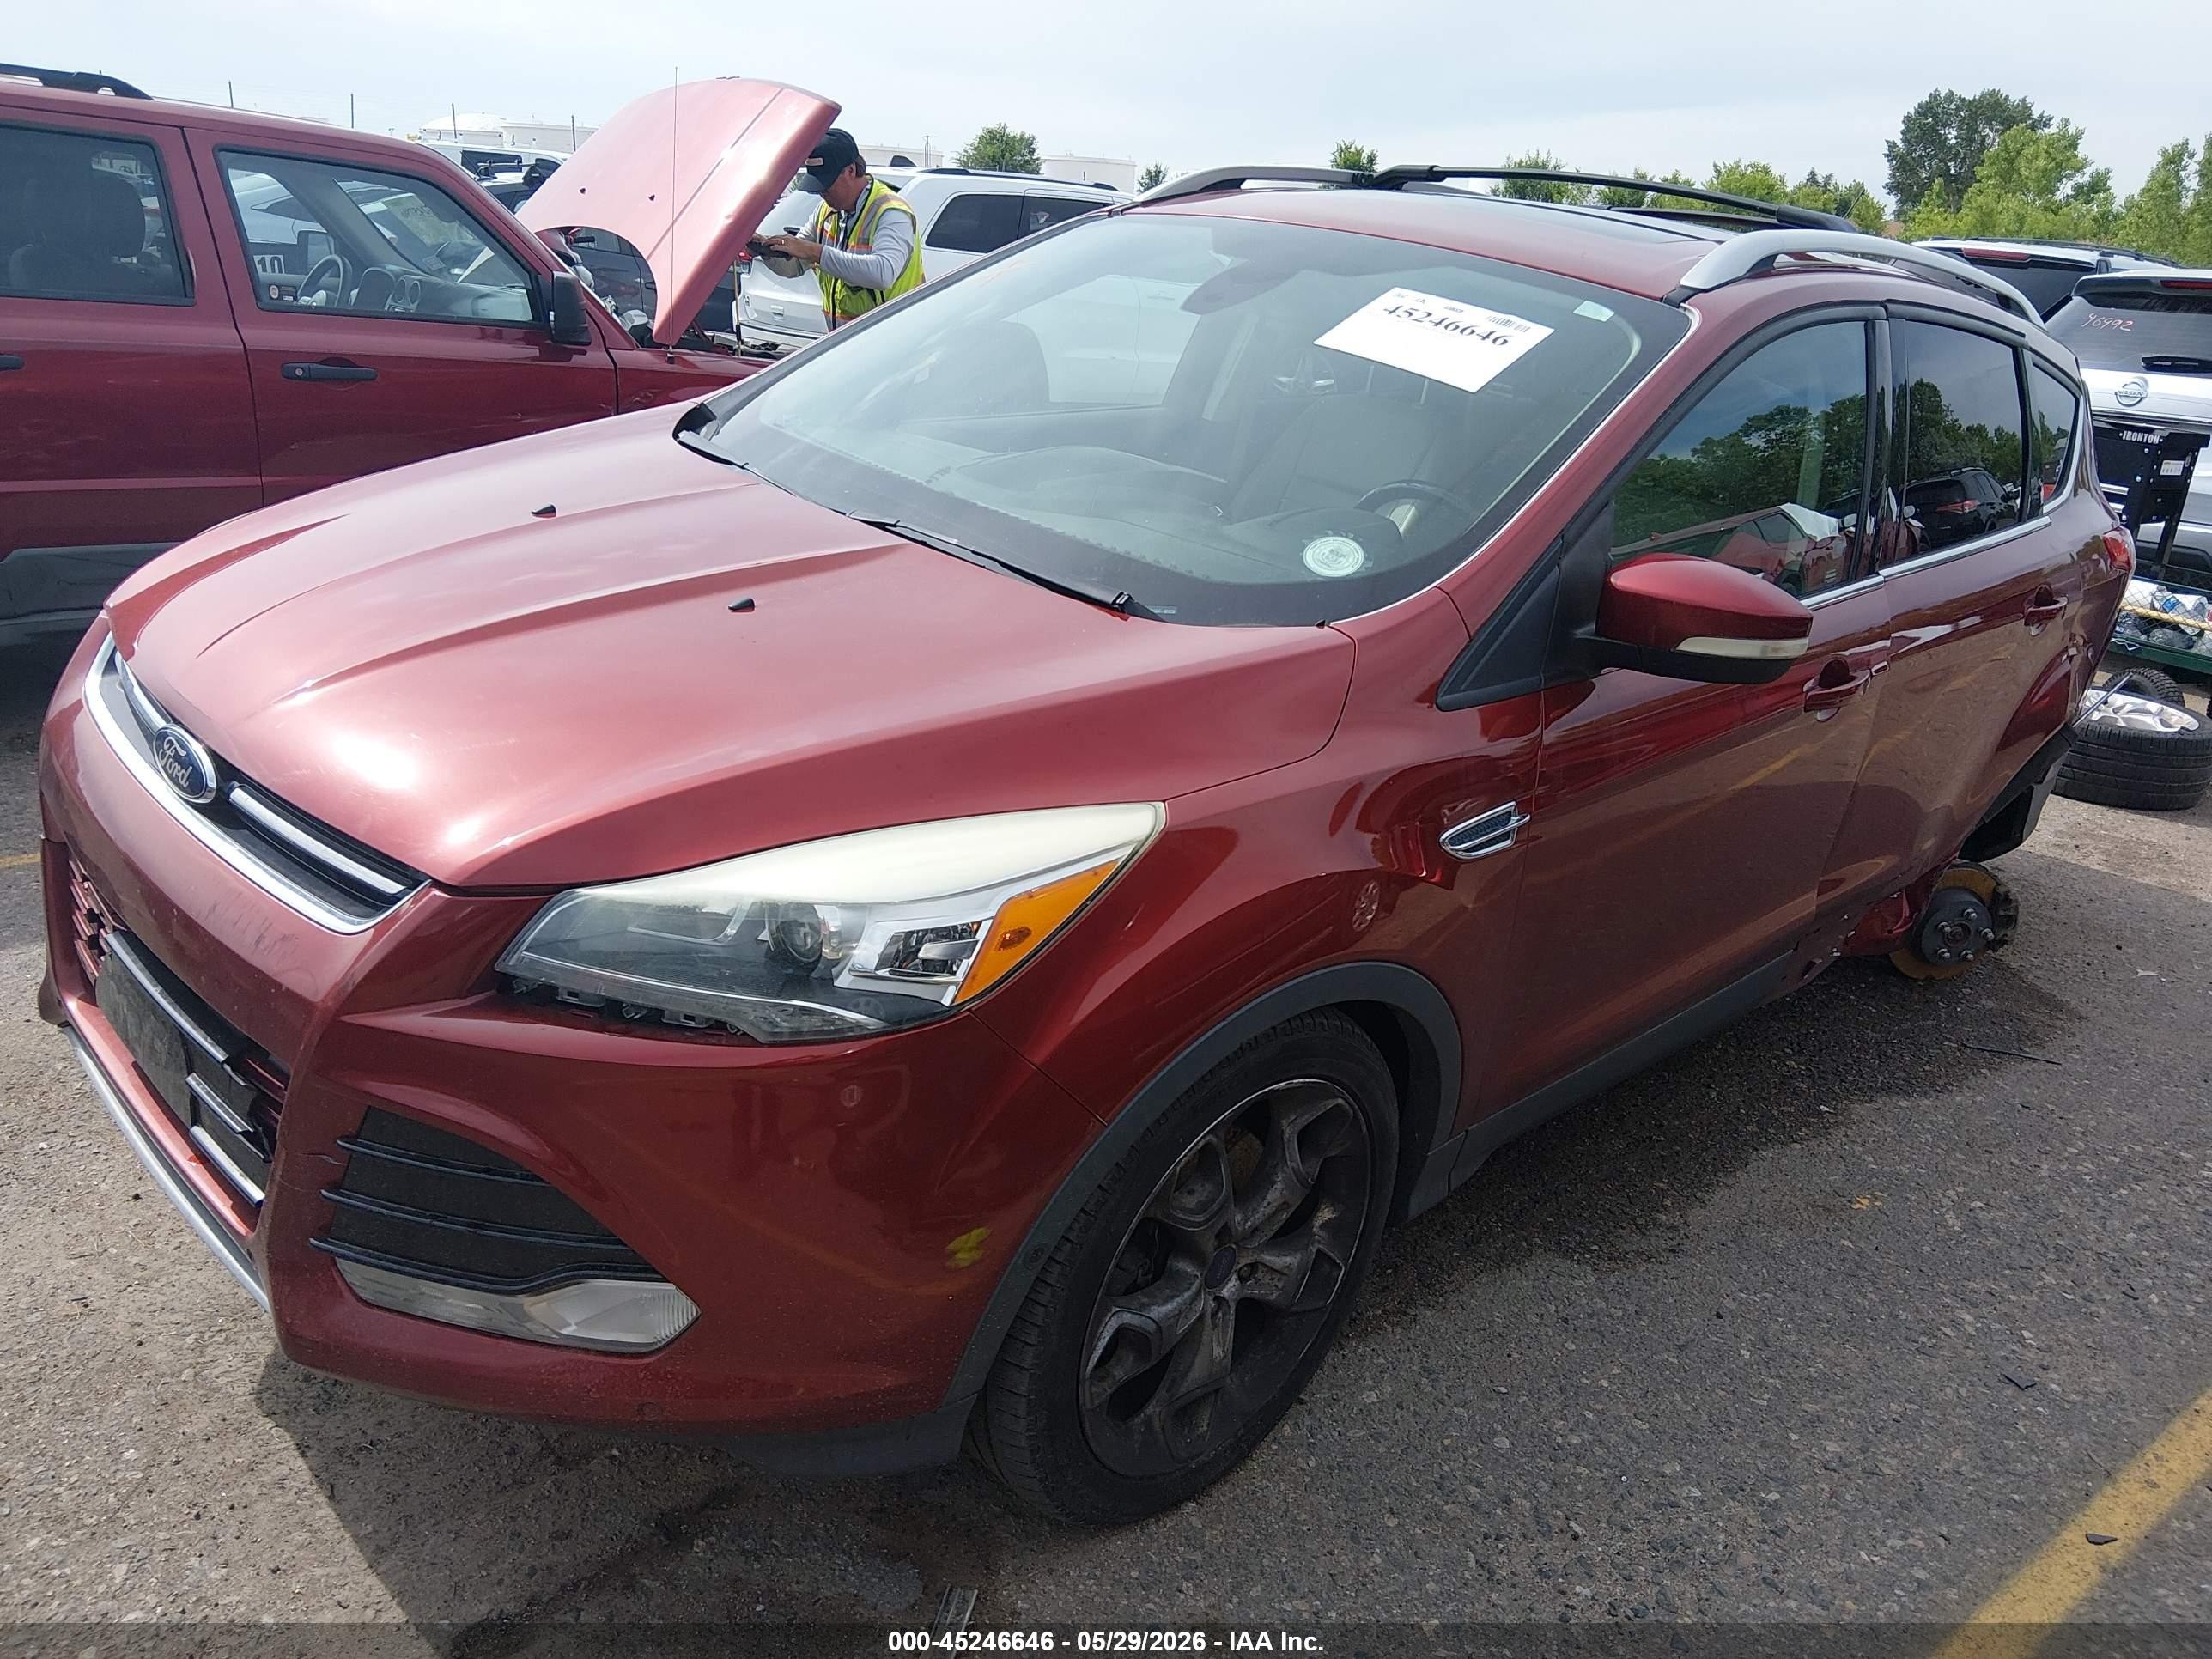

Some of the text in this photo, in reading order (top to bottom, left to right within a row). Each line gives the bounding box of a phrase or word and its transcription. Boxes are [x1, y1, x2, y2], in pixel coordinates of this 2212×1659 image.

[1383, 305, 1514, 346] 45246646
[2122, 430, 2160, 444] IRONTON
[159, 736, 193, 788] Ford
